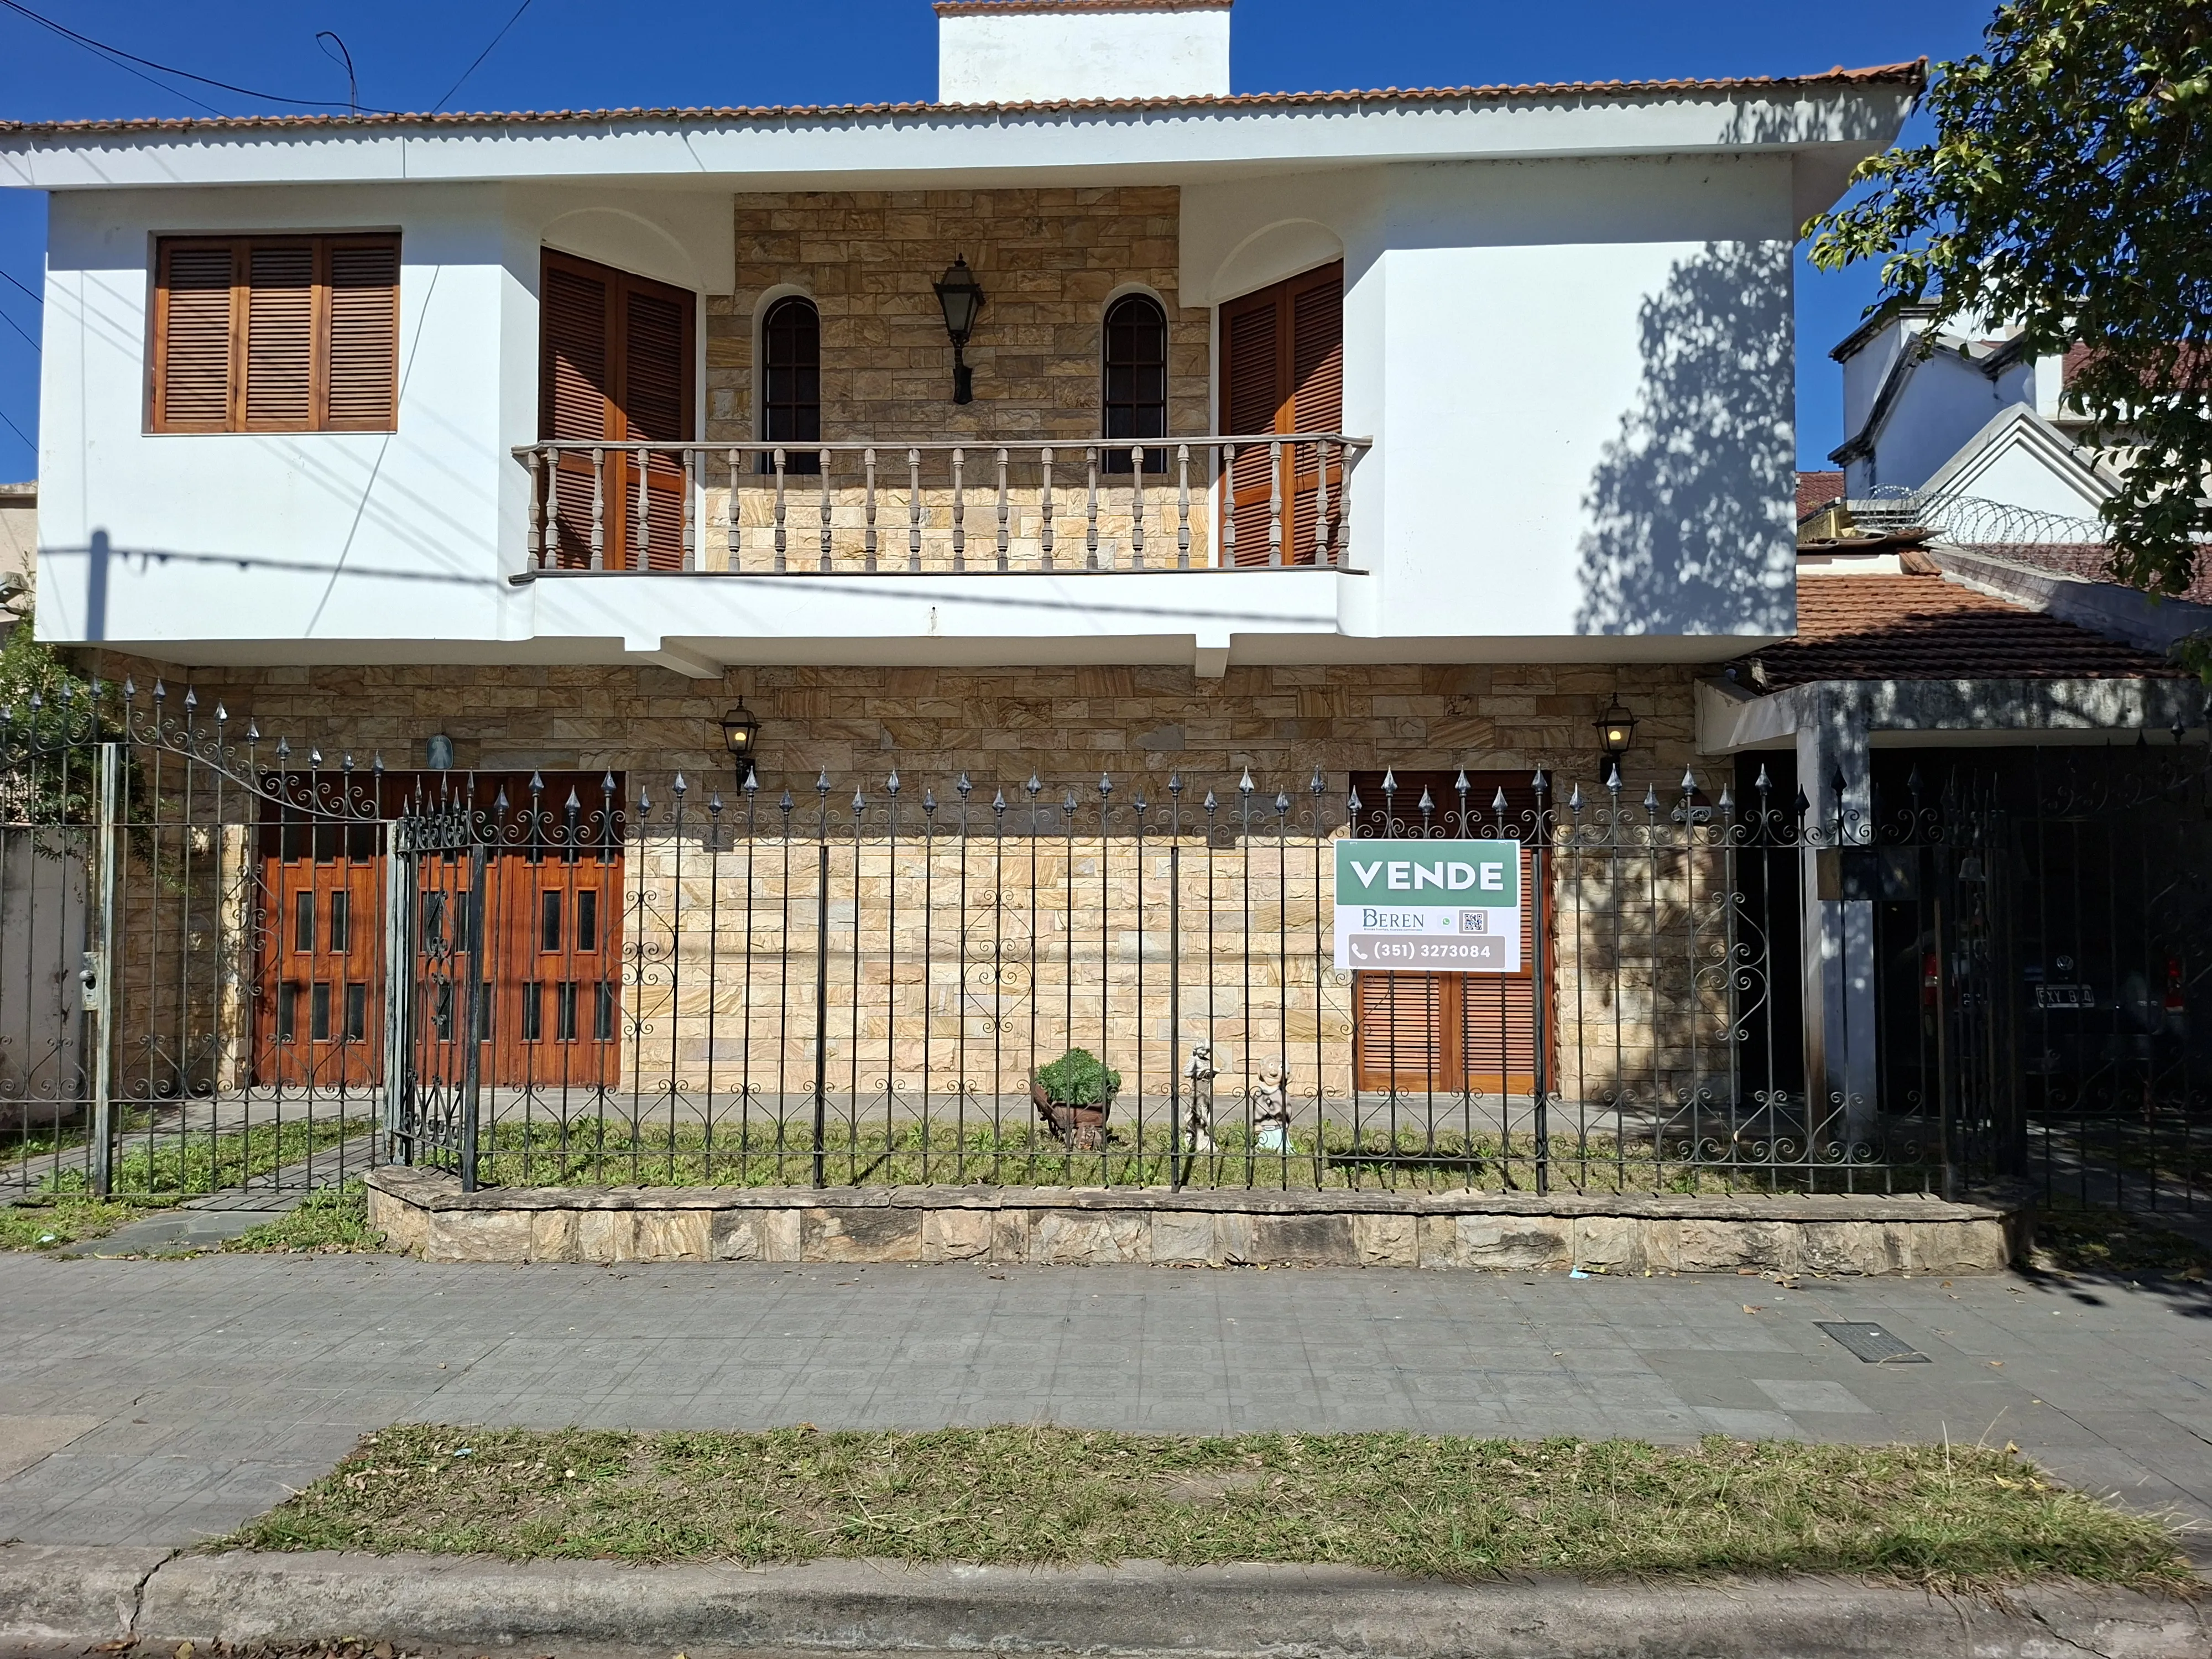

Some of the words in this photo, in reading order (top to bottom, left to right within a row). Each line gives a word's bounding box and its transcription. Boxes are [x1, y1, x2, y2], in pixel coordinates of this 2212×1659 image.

[1349, 861, 1504, 890] VENDE
[1362, 909, 1425, 927] BEREN
[1374, 942, 1415, 959] (351)
[1421, 945, 1490, 957] 3273084
[2068, 990, 2091, 1003] 84
